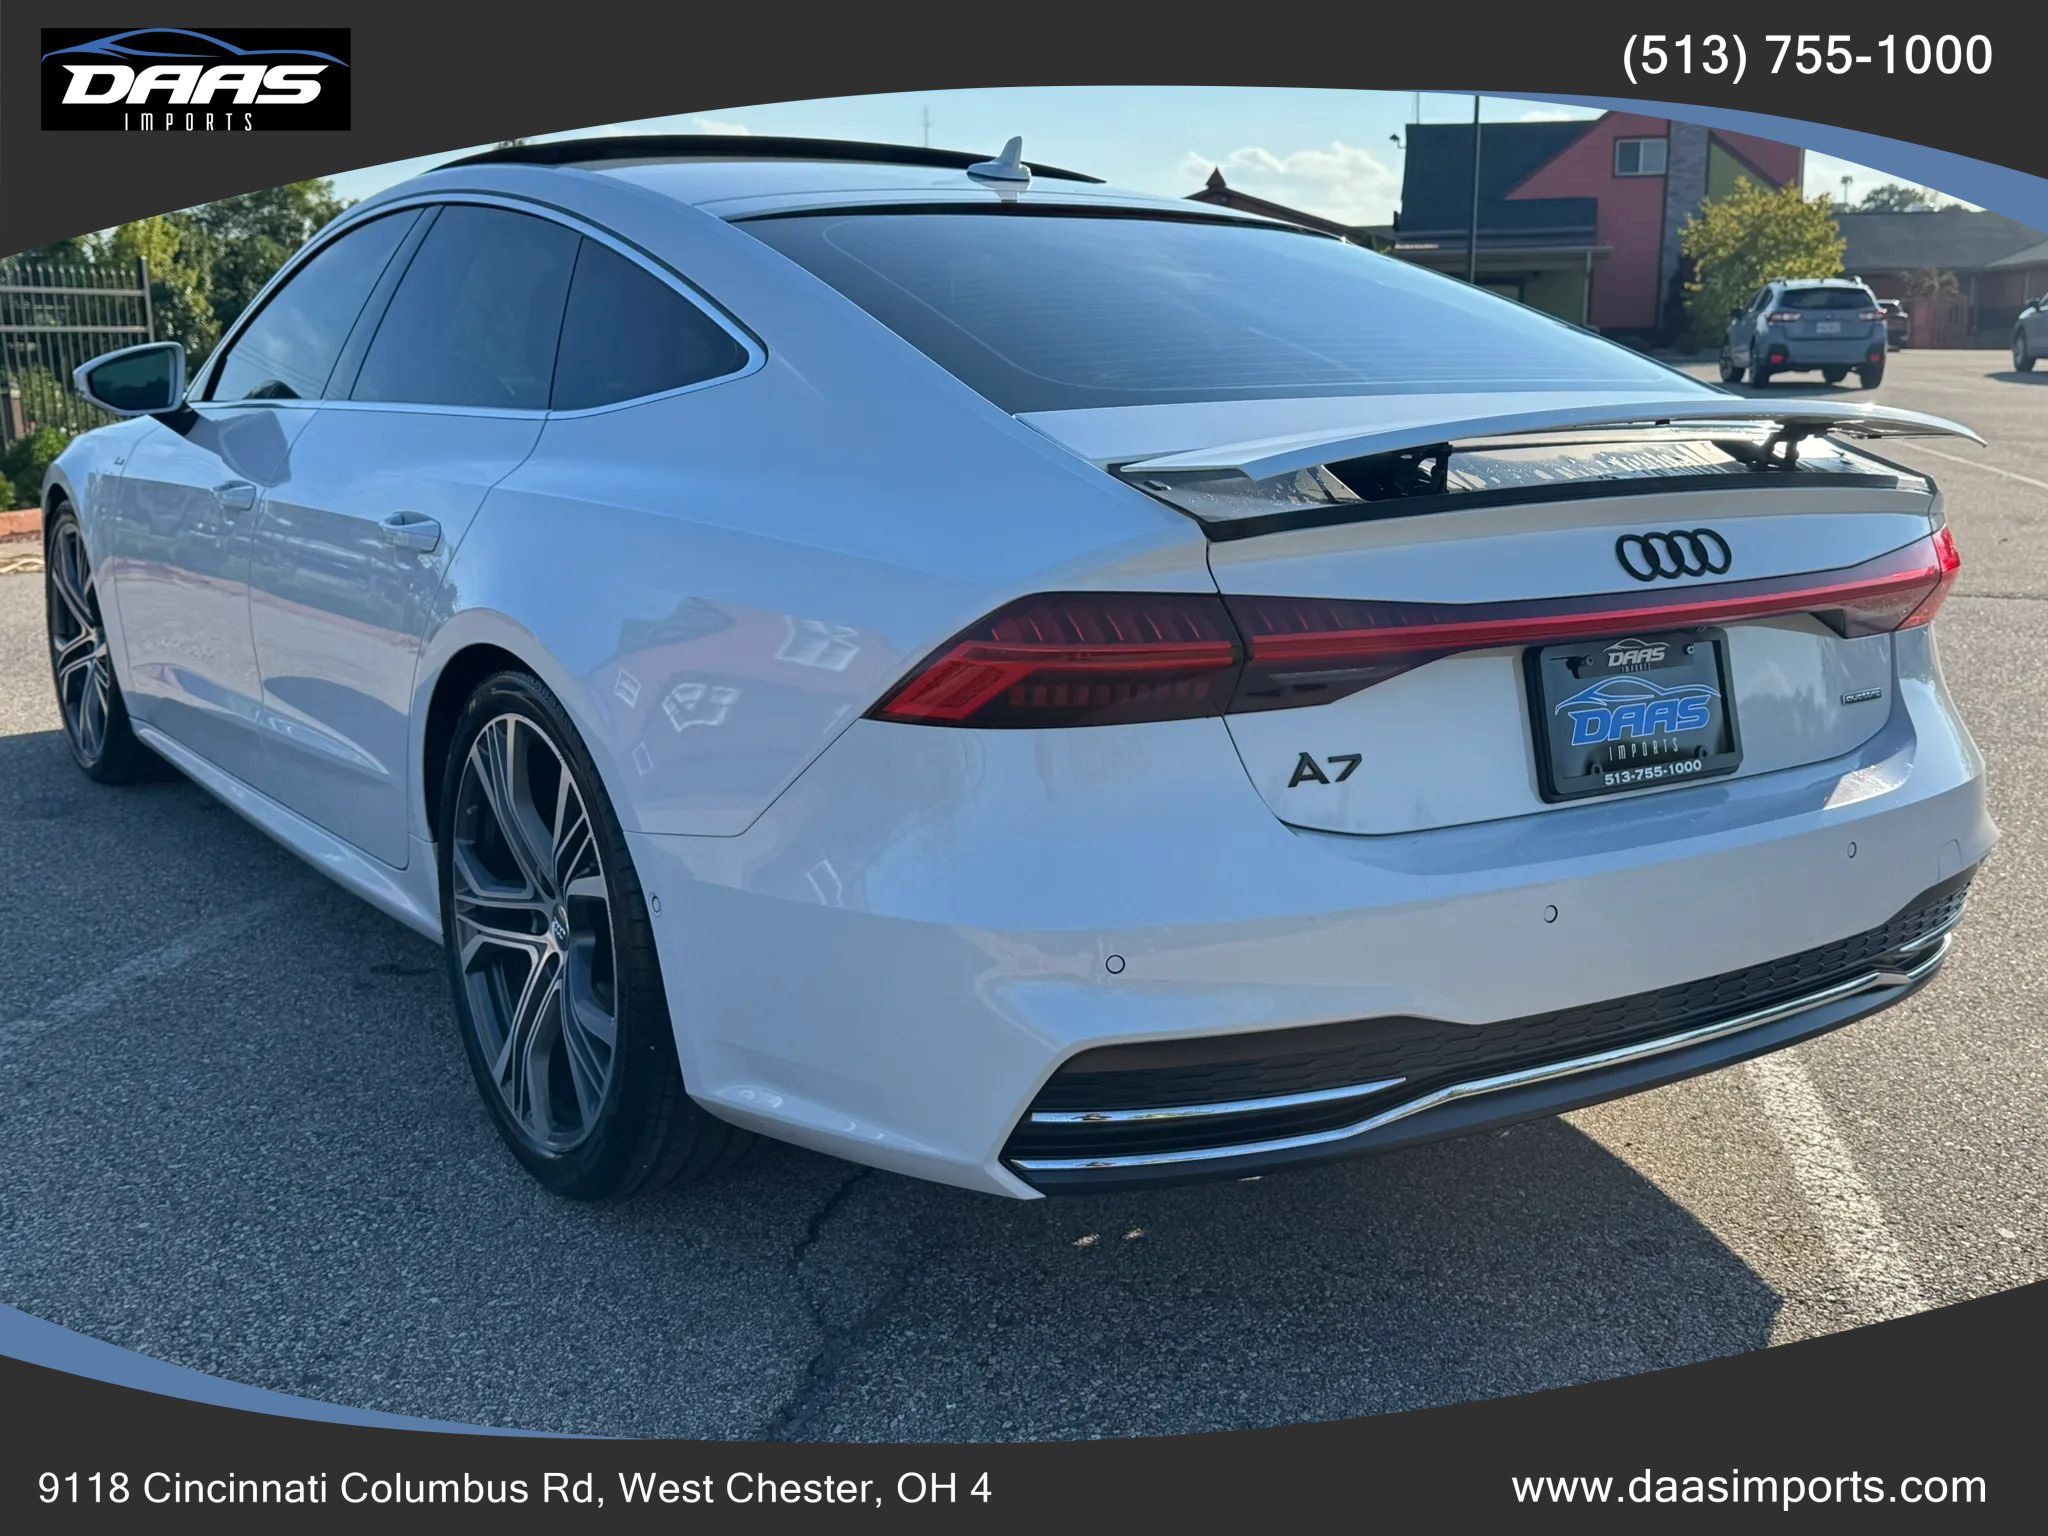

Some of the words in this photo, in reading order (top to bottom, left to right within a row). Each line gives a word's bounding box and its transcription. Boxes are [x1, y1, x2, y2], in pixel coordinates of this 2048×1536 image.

[1607, 647, 1666, 667] DAAS
[1568, 694, 1711, 746] DAAS
[1609, 737, 1679, 761] IMPORTS
[1287, 751, 1363, 788] A7
[1604, 759, 1702, 786] 513-755-1000
